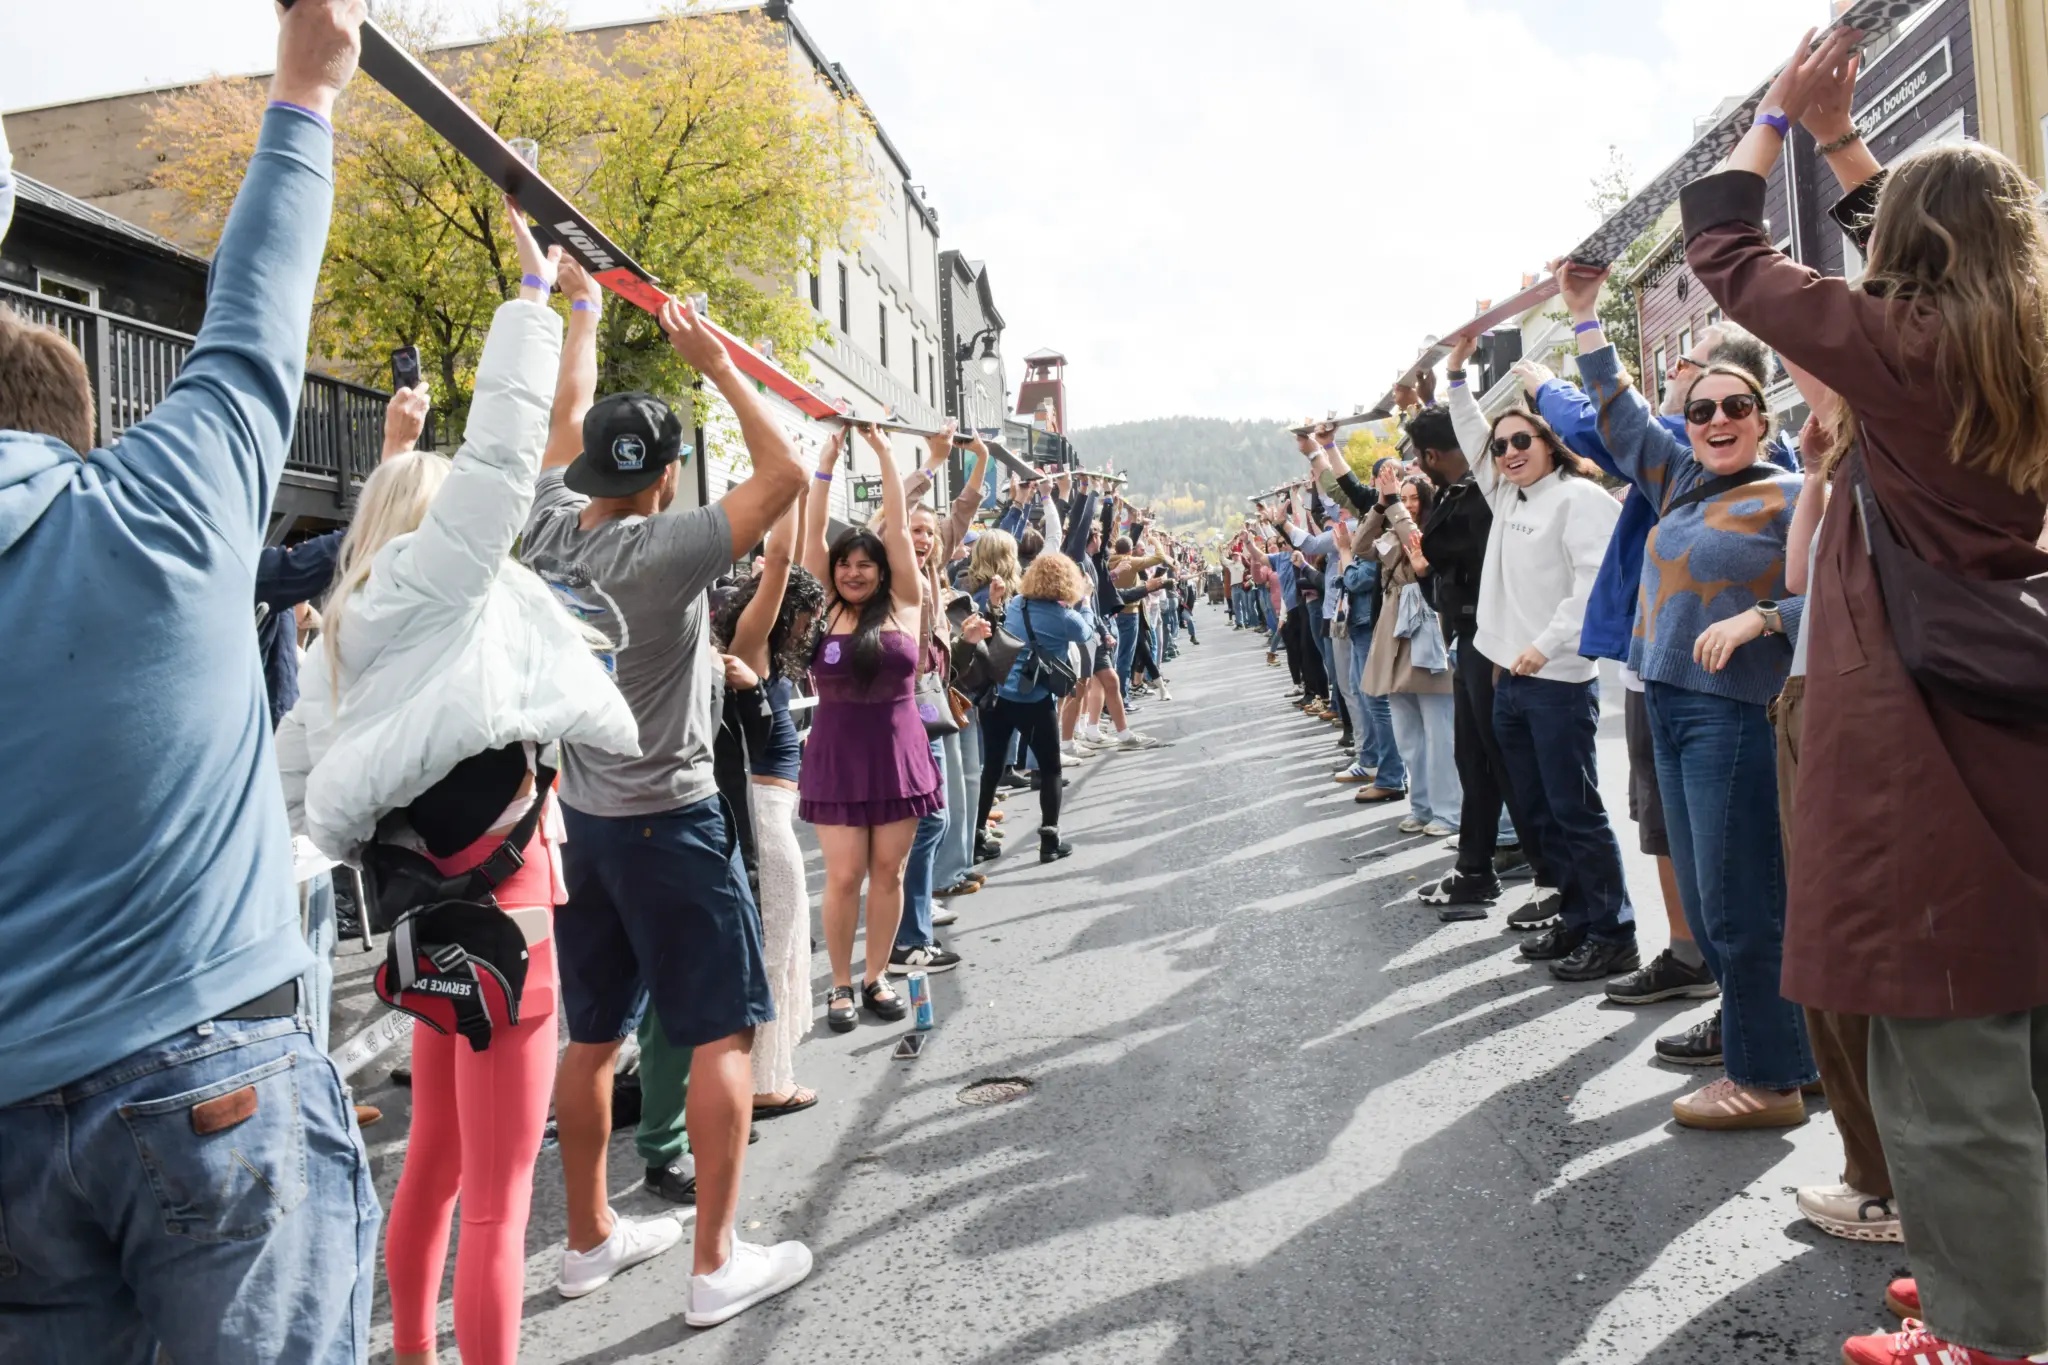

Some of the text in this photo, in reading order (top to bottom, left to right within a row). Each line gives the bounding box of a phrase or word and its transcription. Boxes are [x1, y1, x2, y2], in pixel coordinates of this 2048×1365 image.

[1883, 70, 1928, 115] boutique
[552, 219, 616, 270] Völk
[867, 484, 883, 496] sti
[412, 979, 472, 996] SERVICE DO
